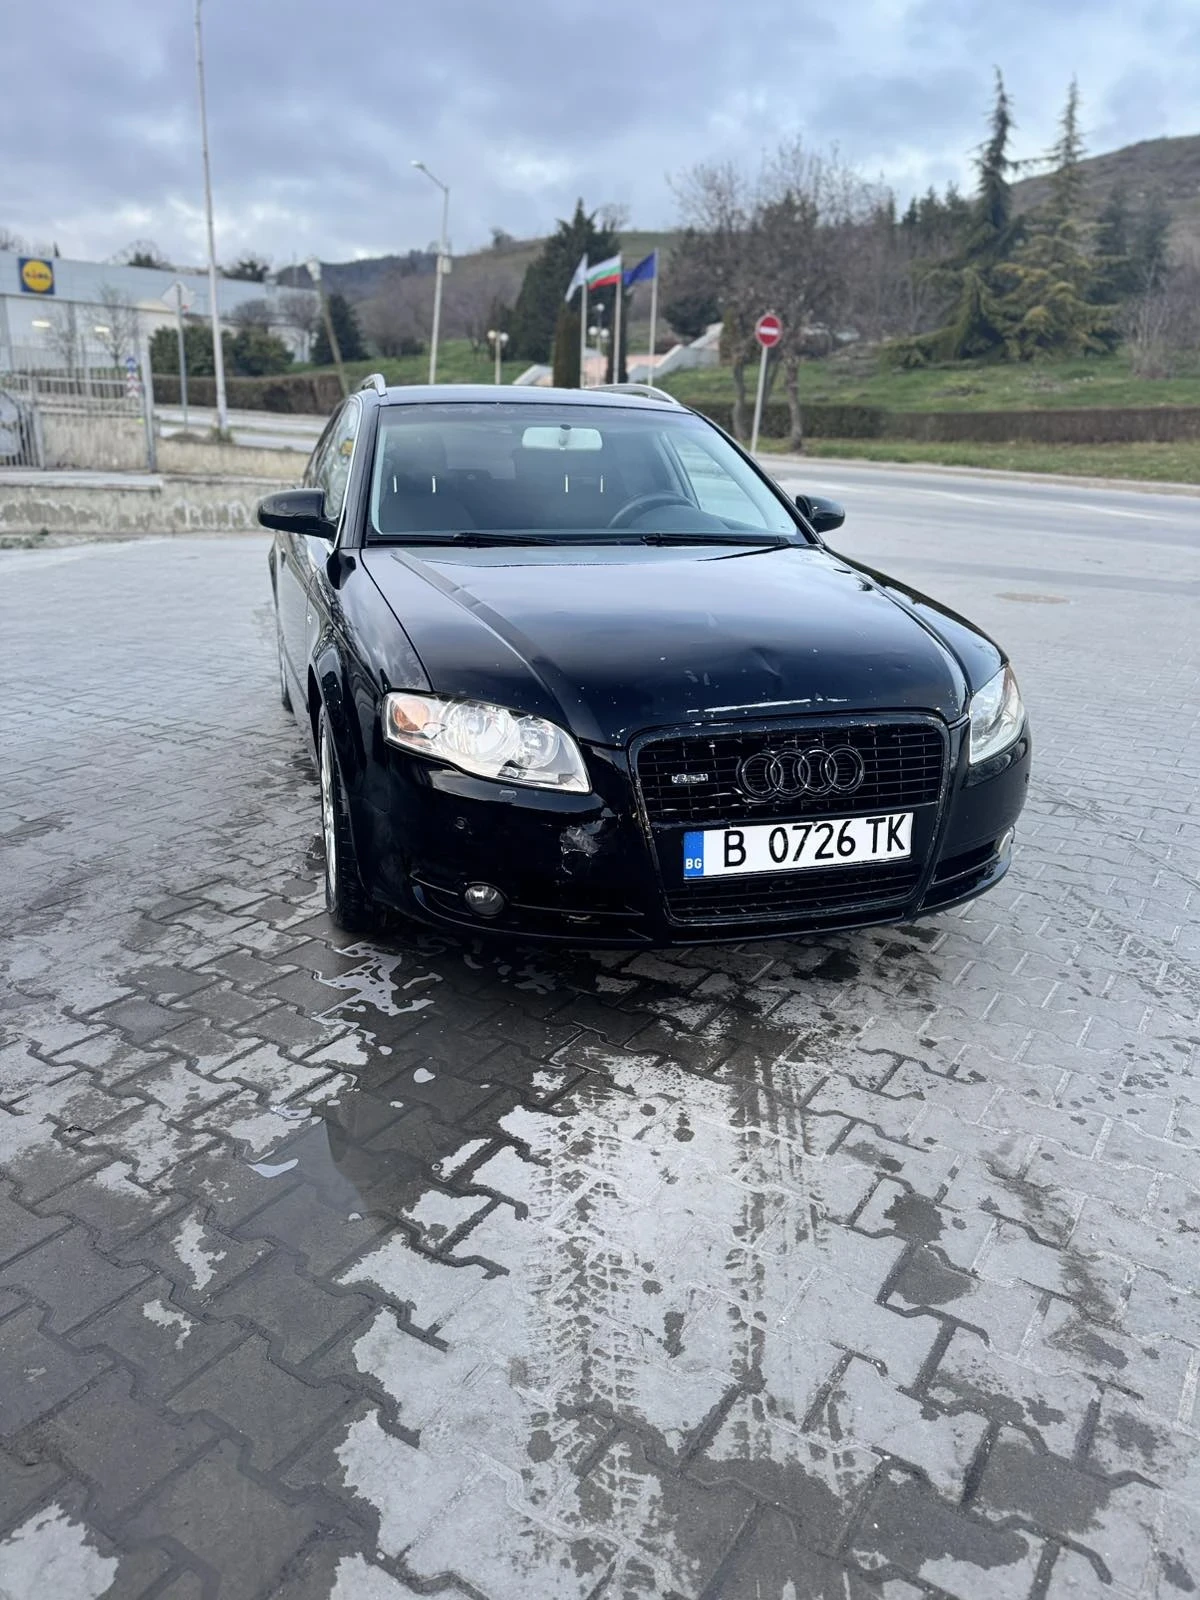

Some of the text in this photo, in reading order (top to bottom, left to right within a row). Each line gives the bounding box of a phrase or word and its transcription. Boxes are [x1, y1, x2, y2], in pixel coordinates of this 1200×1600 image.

[723, 814, 906, 868] B 0726 TK
[685, 858, 702, 870] BG
